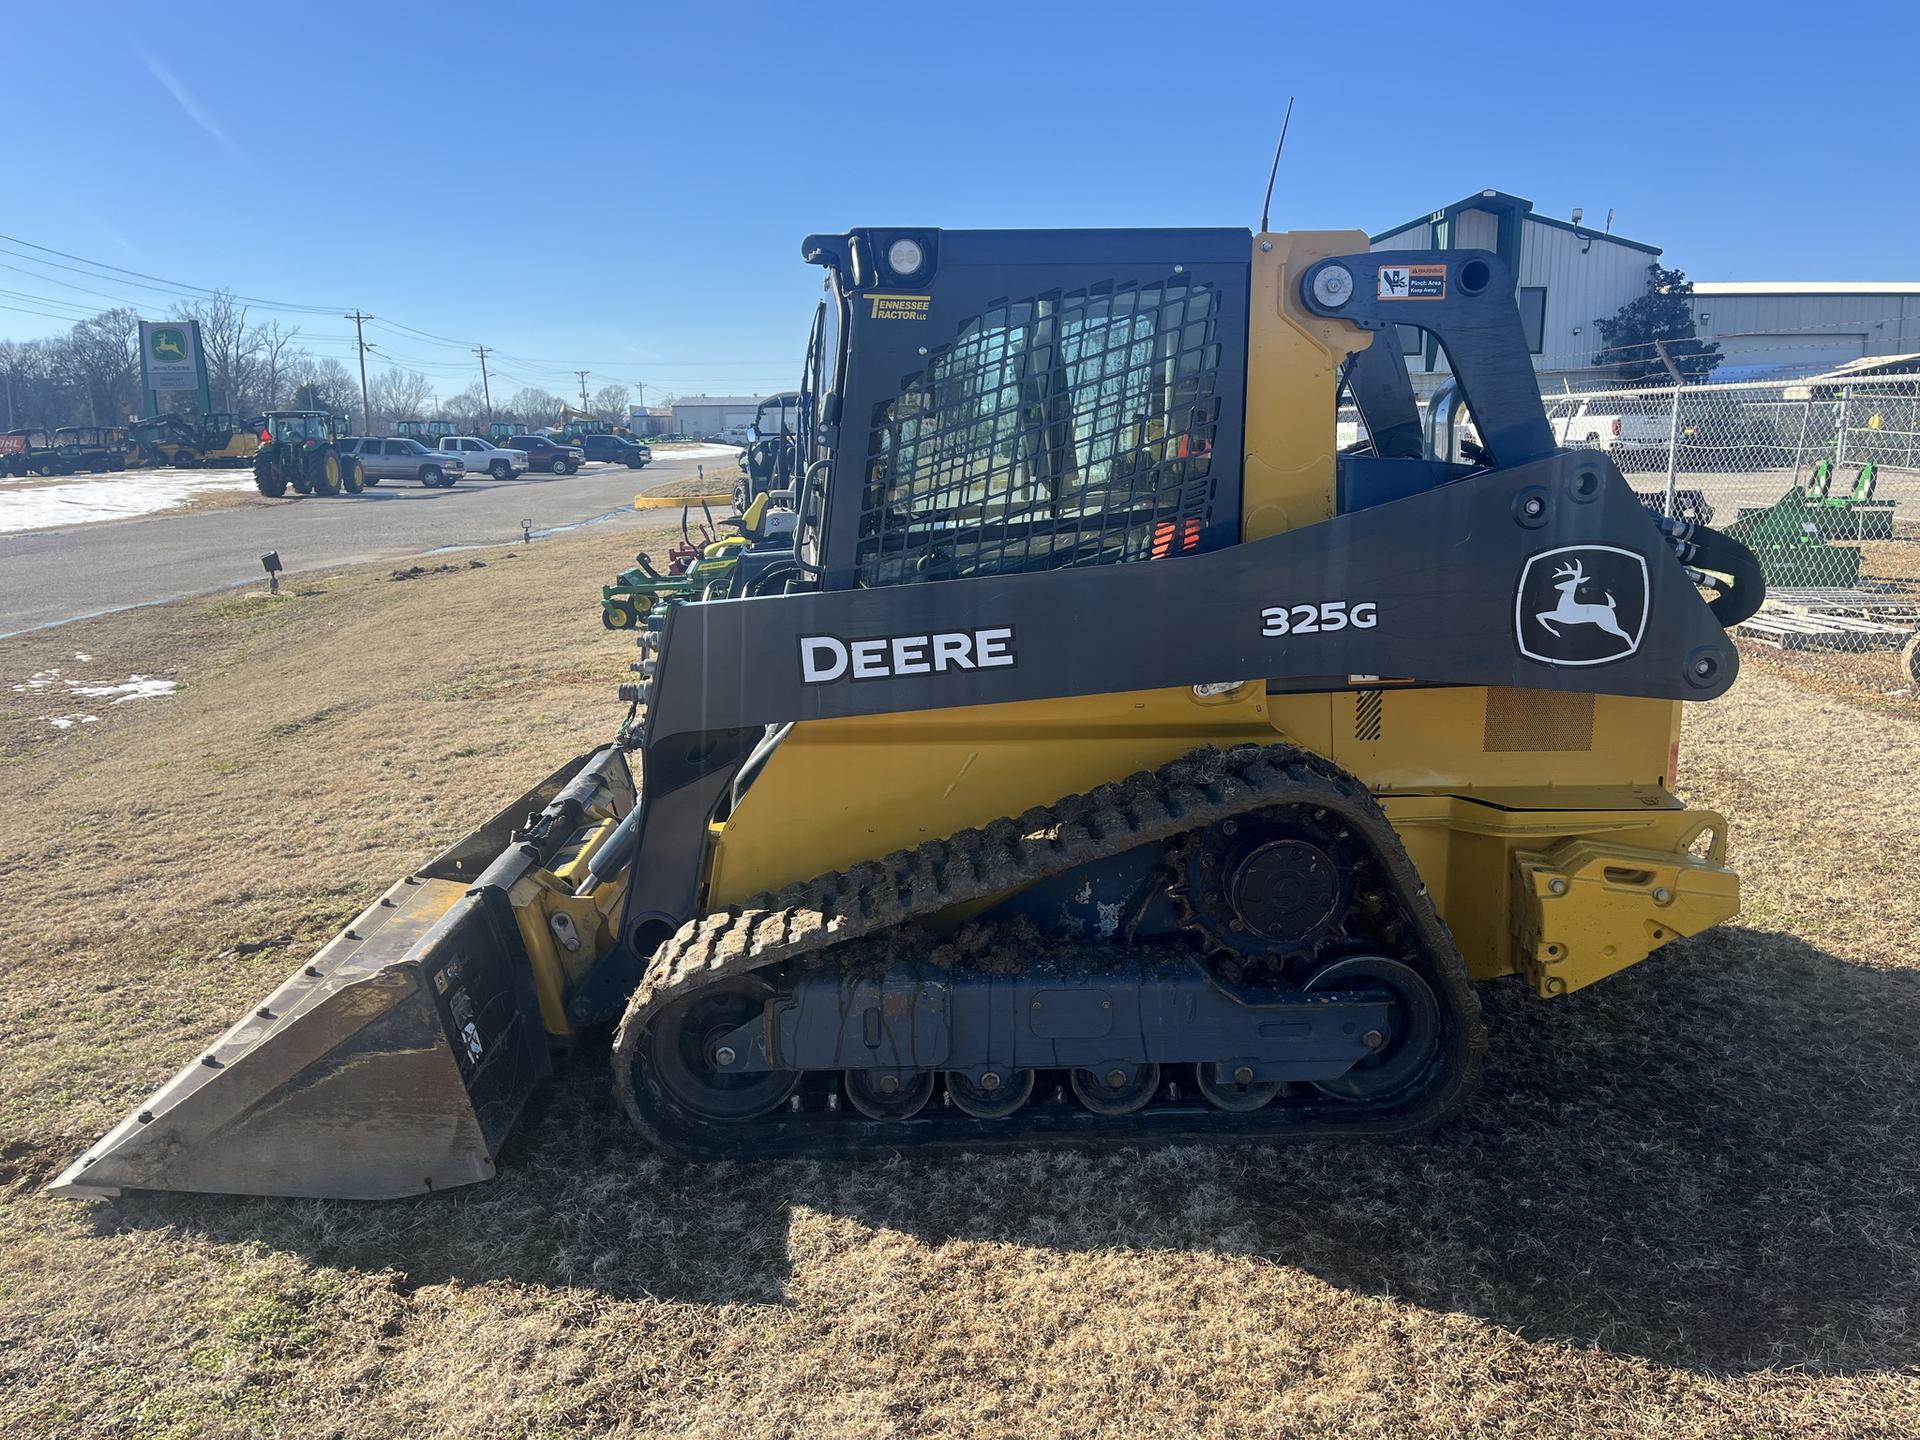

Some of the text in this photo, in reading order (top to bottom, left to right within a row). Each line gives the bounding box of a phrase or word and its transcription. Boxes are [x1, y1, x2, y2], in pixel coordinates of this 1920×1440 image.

[863, 294, 931, 313] TENNESSEE
[1261, 601, 1377, 636] 325G
[801, 628, 1013, 683] DEERE
